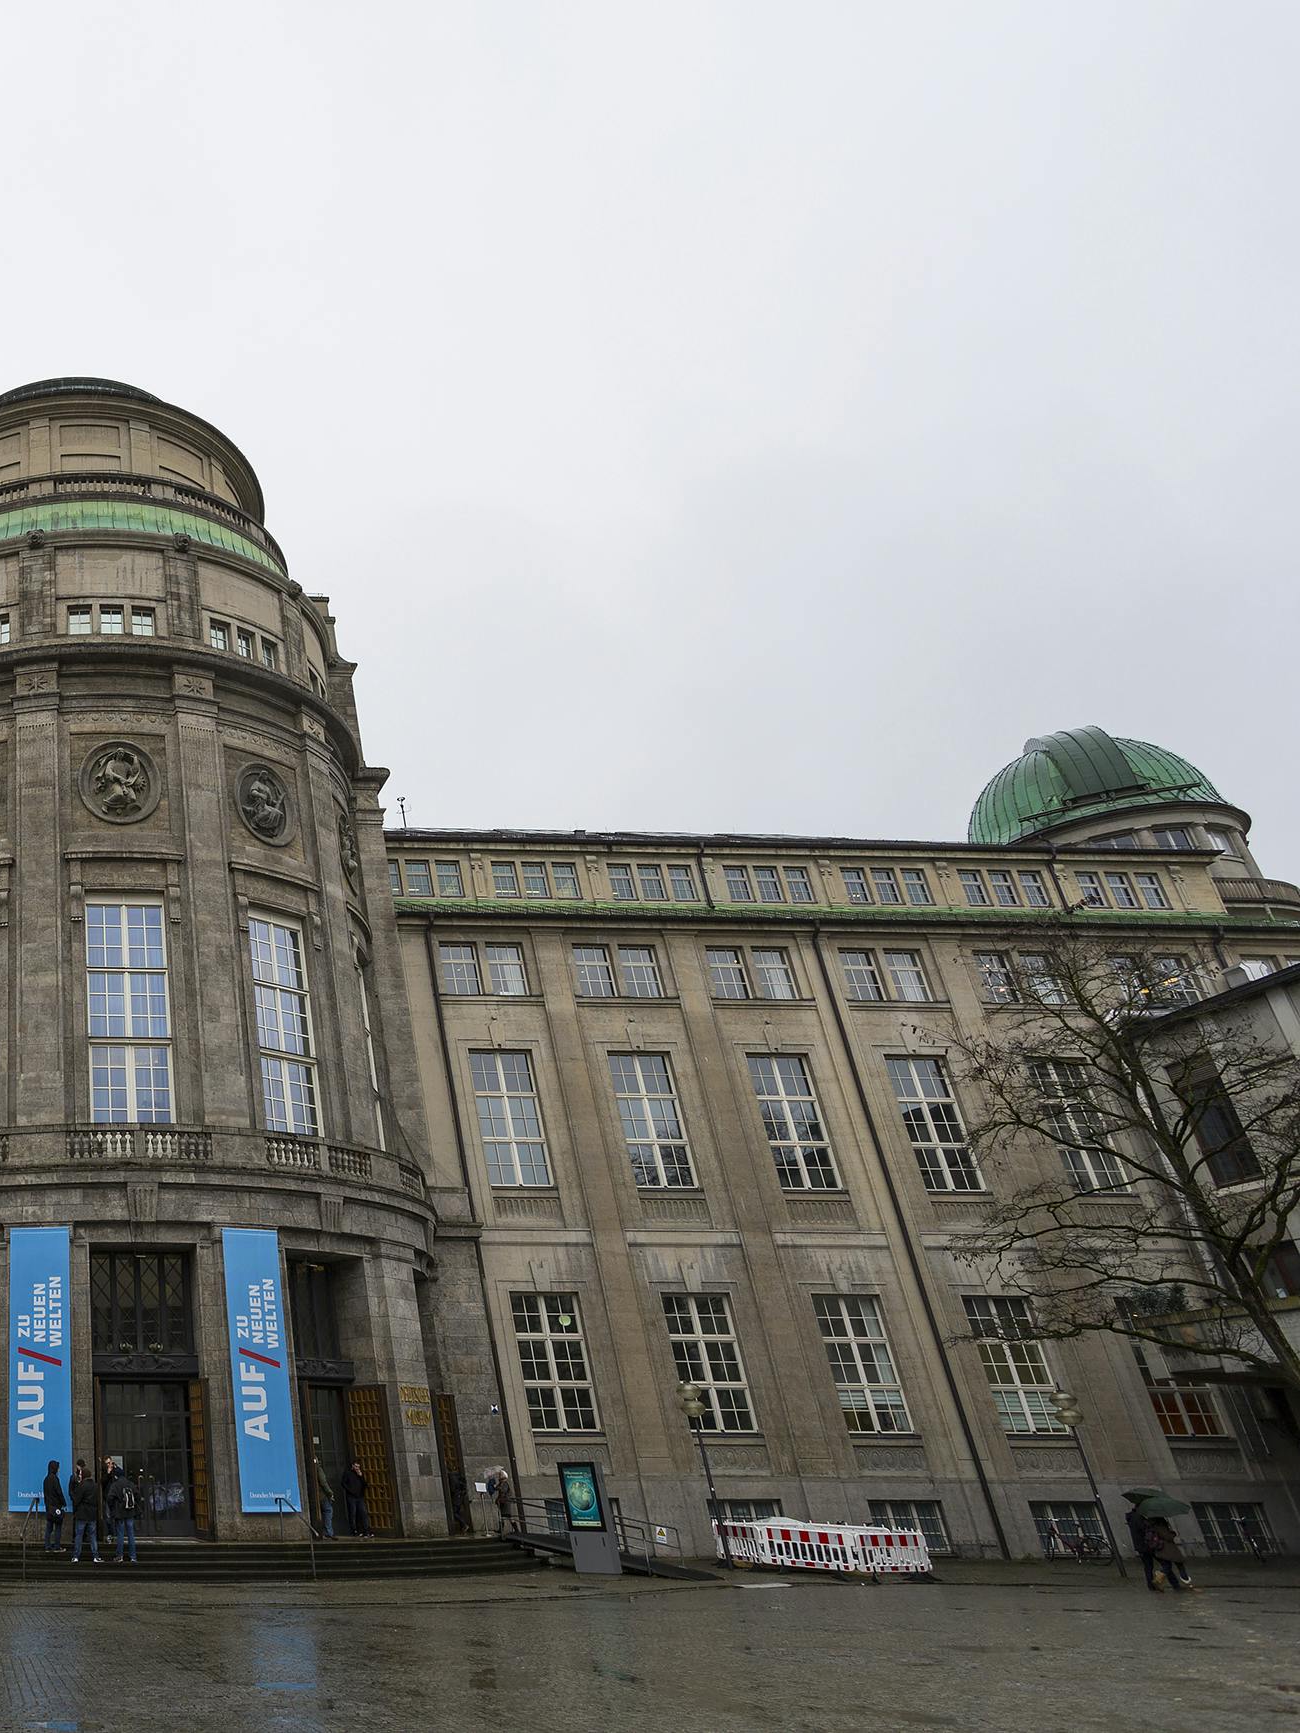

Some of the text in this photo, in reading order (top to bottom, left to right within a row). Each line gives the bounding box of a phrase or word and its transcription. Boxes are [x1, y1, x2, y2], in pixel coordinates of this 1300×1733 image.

[17, 1315, 30, 1338] ZU
[33, 1283, 46, 1343] NEUEN
[49, 1276, 61, 1347] WELTEN
[236, 1315, 249, 1338] ZU
[249, 1284, 264, 1344] NEUEN
[262, 1279, 280, 1349] WELTEN
[17, 1362, 45, 1441] AUF
[240, 1362, 270, 1441] AUF
